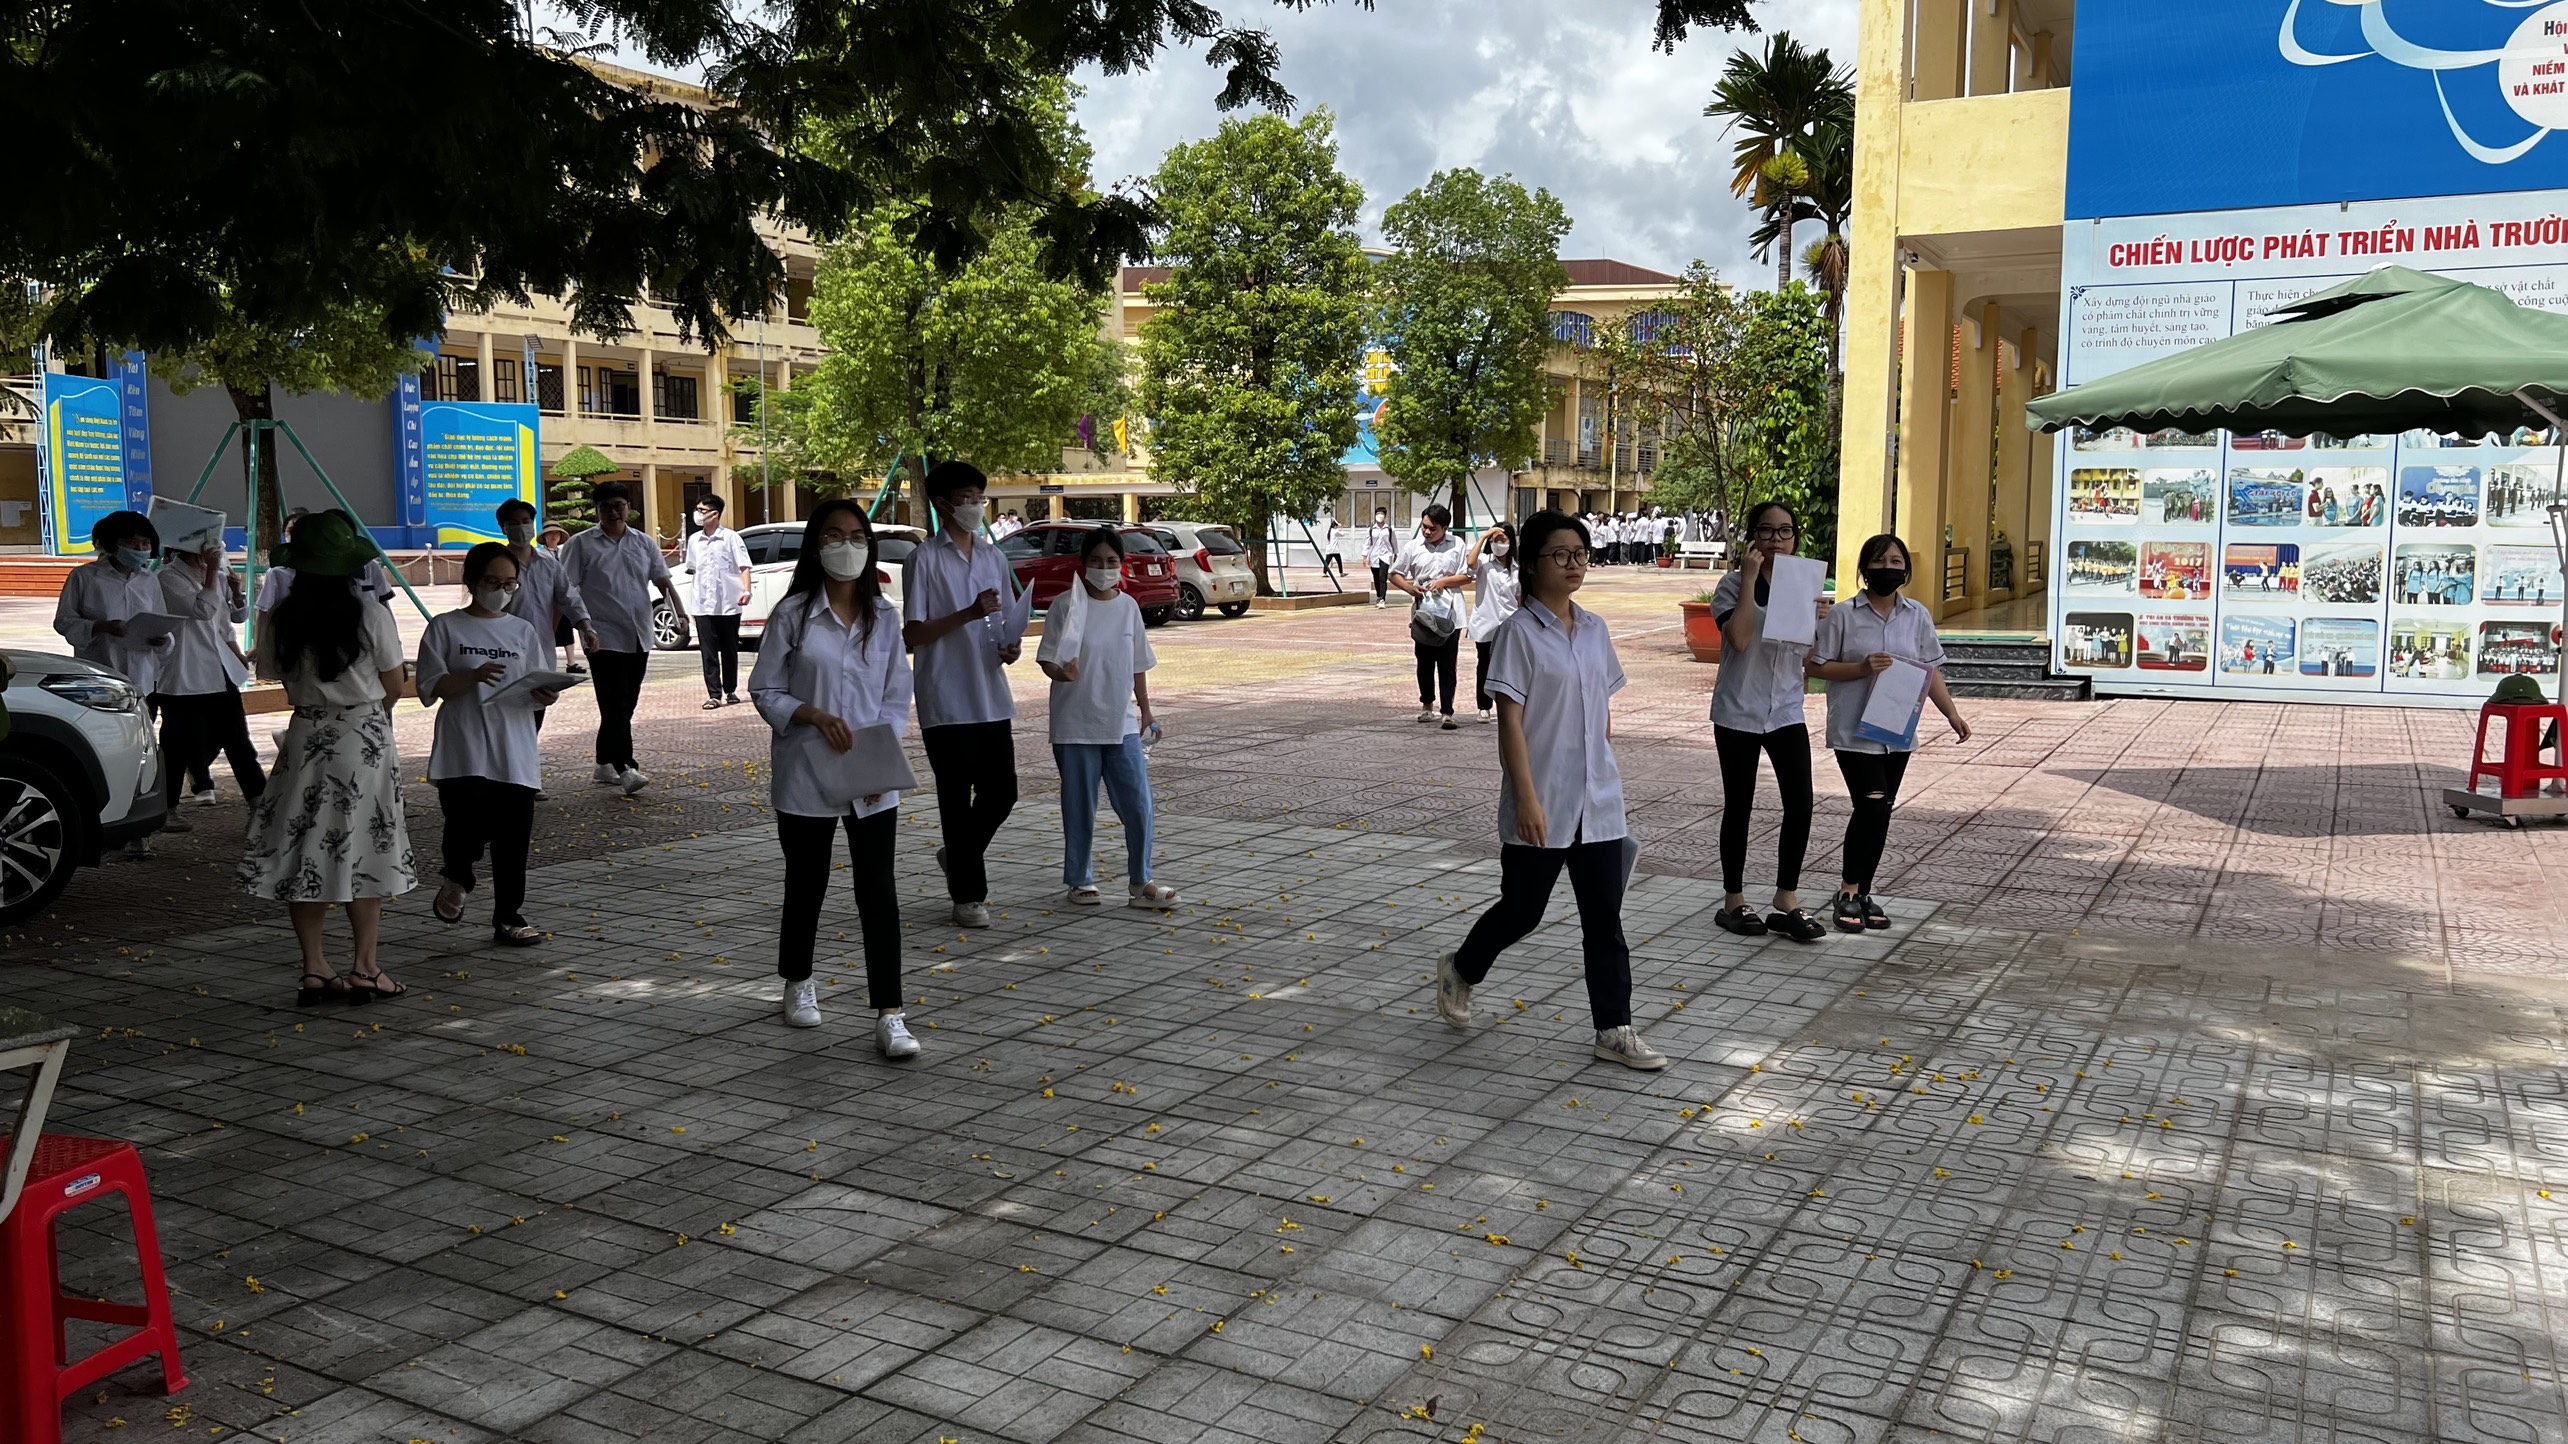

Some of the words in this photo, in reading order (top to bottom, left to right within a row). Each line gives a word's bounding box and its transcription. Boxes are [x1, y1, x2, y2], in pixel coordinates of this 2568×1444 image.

[2514, 82, 2529, 96] VÀ
[2532, 80, 2565, 95] KHÁT
[2109, 234, 2182, 266] CHIẾN
[2190, 236, 2254, 267] LƯỢC
[2263, 229, 2330, 259] PHÁT
[2338, 219, 2415, 256] TRIỂN
[2424, 219, 2480, 251] NHÀ
[2511, 281, 2527, 292] vật
[2531, 277, 2554, 290] chất
[2083, 297, 2101, 309] Xây
[2106, 296, 2130, 308] dựng
[2133, 295, 2148, 307] đội
[2174, 294, 2190, 303] nhà
[2194, 294, 2215, 305] giáo
[2248, 291, 2274, 302] Thực
[2278, 289, 2299, 301] hiện
[2518, 298, 2545, 308] công
[2548, 294, 2568, 305] cuộ
[2082, 312, 2093, 320] có
[2126, 308, 2145, 319] chất
[2149, 308, 2176, 318] chính
[2111, 324, 2128, 333] tâm
[2081, 339, 2092, 348] có
[2120, 337, 2132, 348] độ
[2174, 336, 2196, 345] môn
[2174, 557, 2203, 566] 2017
[460, 644, 520, 659] imagine
